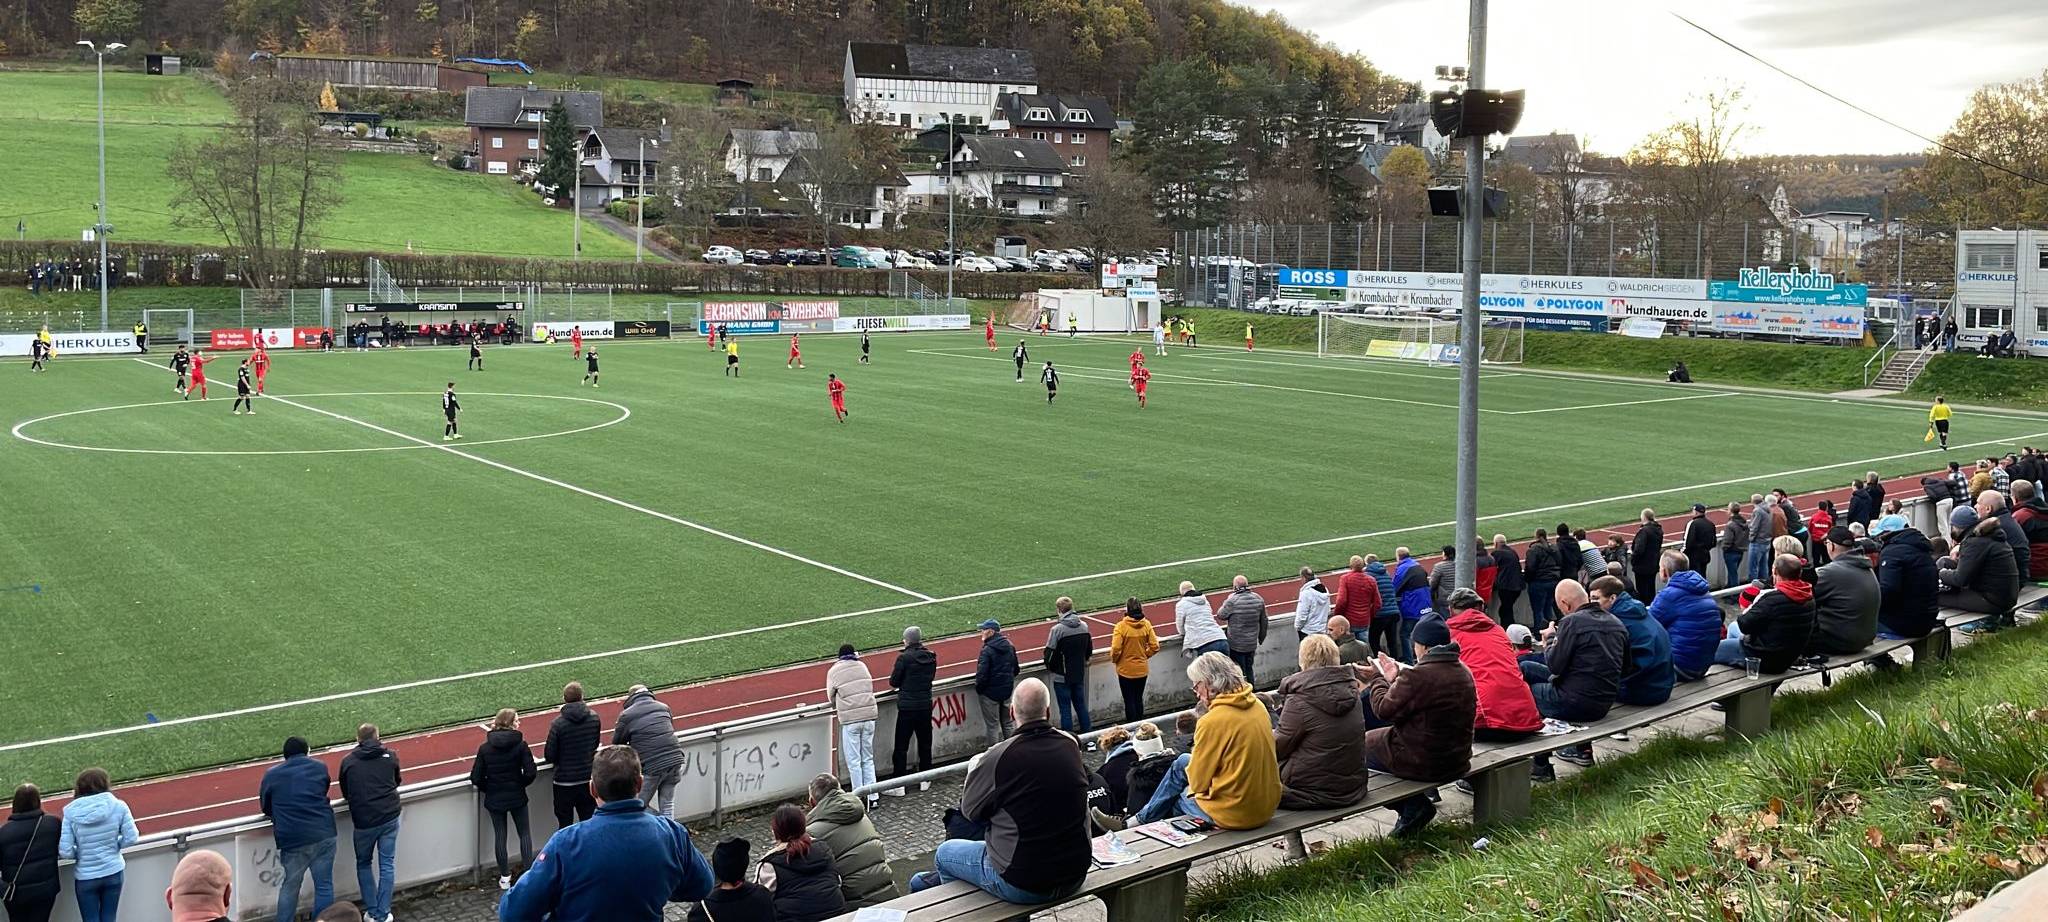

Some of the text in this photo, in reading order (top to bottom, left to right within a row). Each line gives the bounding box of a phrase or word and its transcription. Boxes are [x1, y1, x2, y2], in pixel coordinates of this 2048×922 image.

[1291, 270, 1336, 284] ROSS
[1364, 275, 1407, 284] HERKULES
[1739, 266, 1833, 294] Kellershohn
[1968, 273, 2018, 282] HERKULES
[1531, 279, 1583, 290] HERKULES
[1359, 291, 1399, 304] Krombacher
[1410, 292, 1453, 306] Krombacher
[1480, 296, 1525, 307] OLYGON
[711, 302, 767, 321] KAANSINN
[789, 301, 839, 320] WAHNSINN
[1547, 298, 1603, 311] POLYGON
[1625, 304, 1708, 318] Hundhausen.de
[549, 328, 613, 338] Hundusen.de
[55, 337, 131, 349] HERKULES
[1087, 786, 1107, 799] aset
